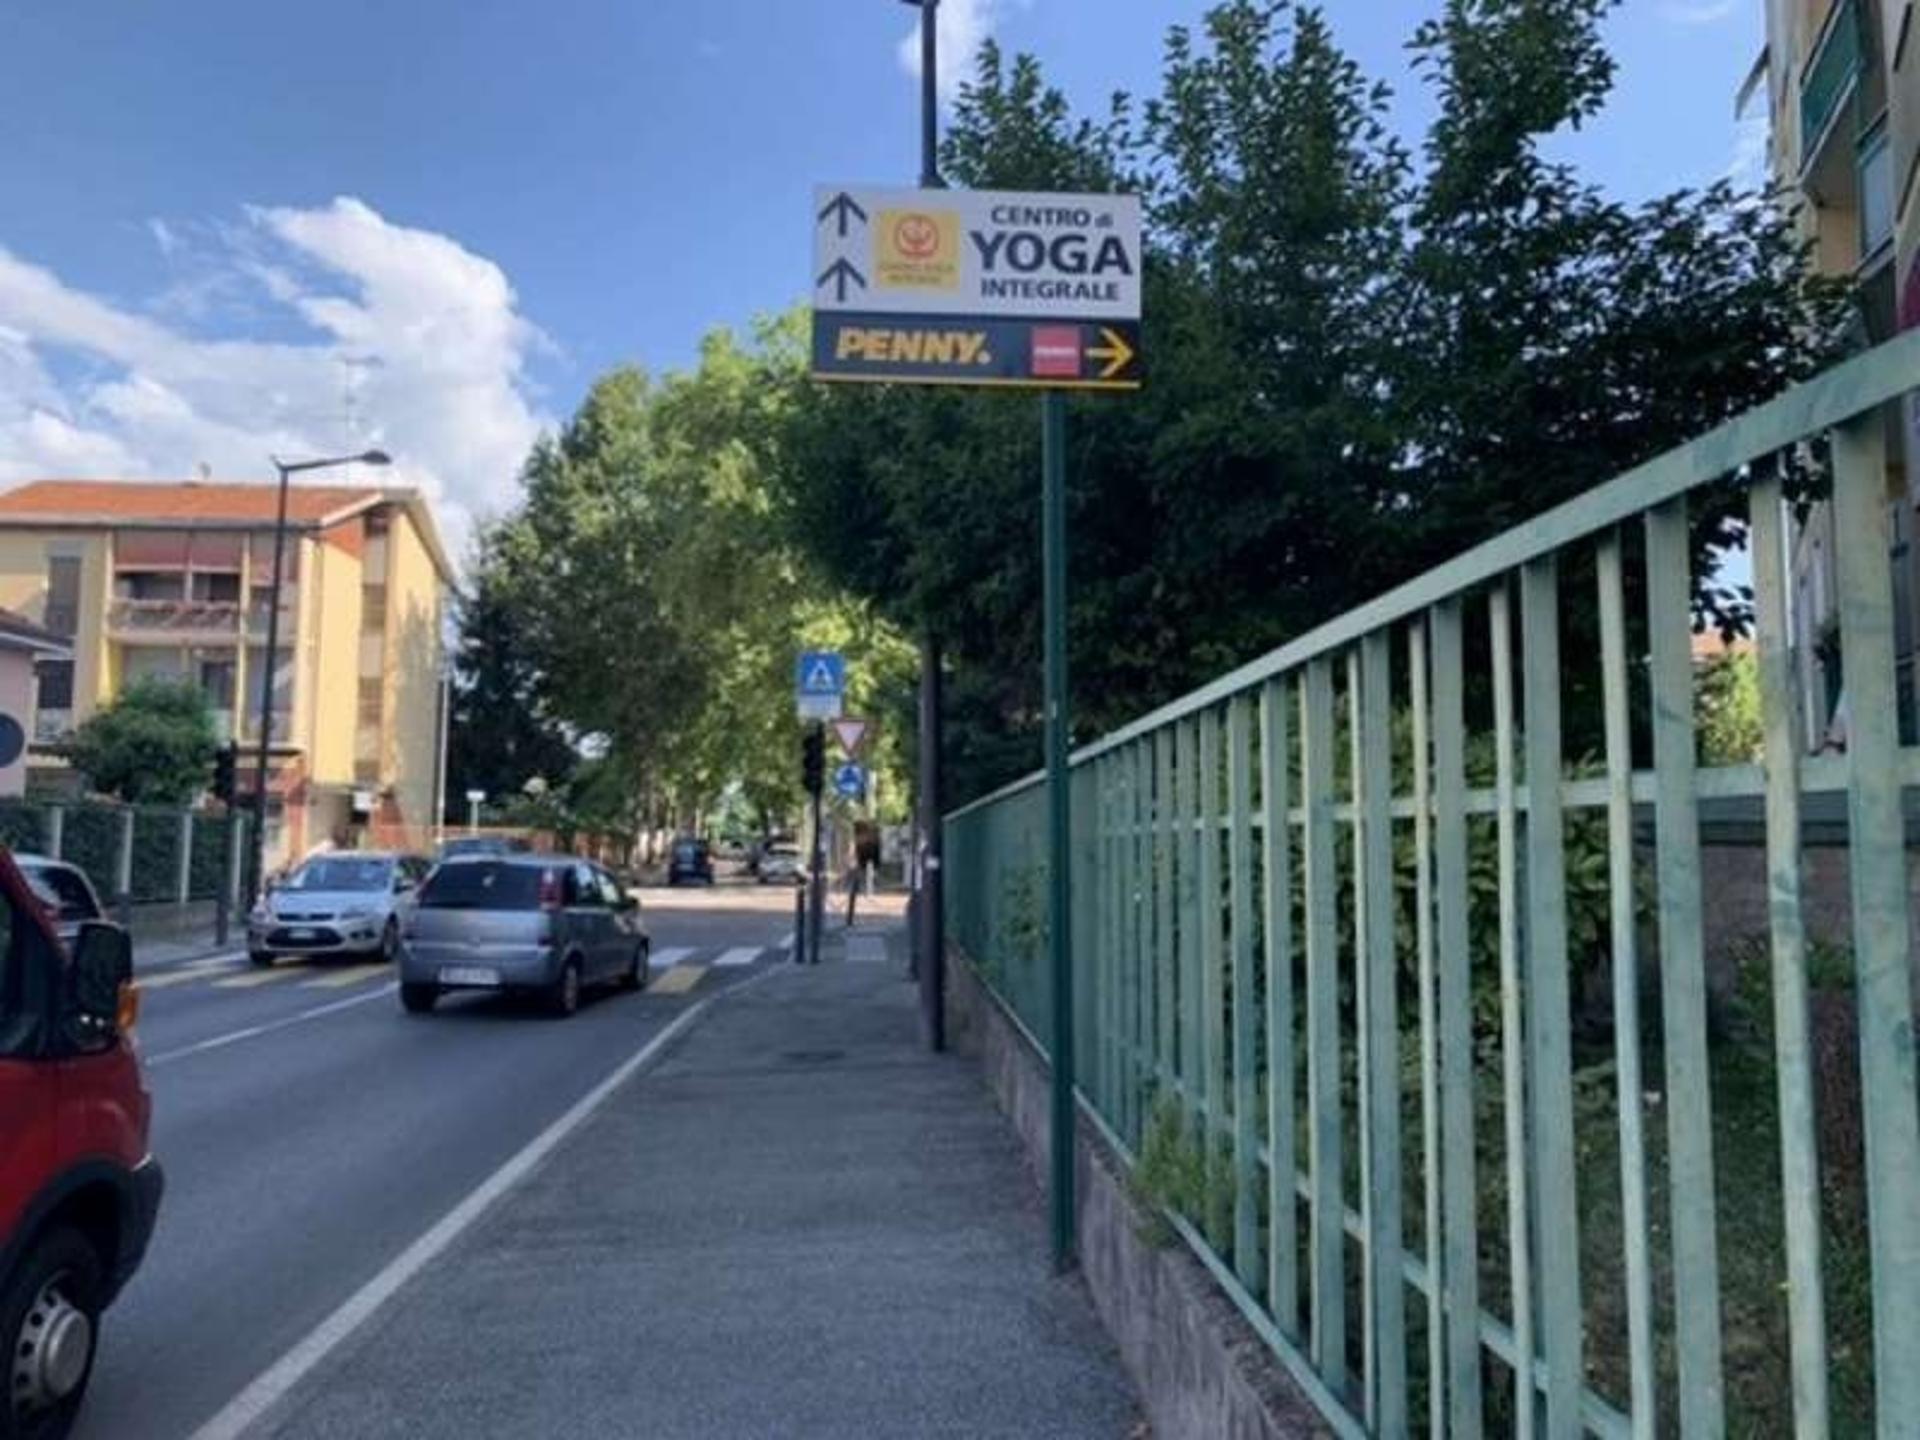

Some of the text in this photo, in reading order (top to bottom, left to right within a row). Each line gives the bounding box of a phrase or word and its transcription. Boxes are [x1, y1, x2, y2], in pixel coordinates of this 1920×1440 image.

[991, 206, 1091, 227] CENTRO
[969, 230, 1133, 276] YOGA
[981, 278, 1119, 301] INTEGRALE
